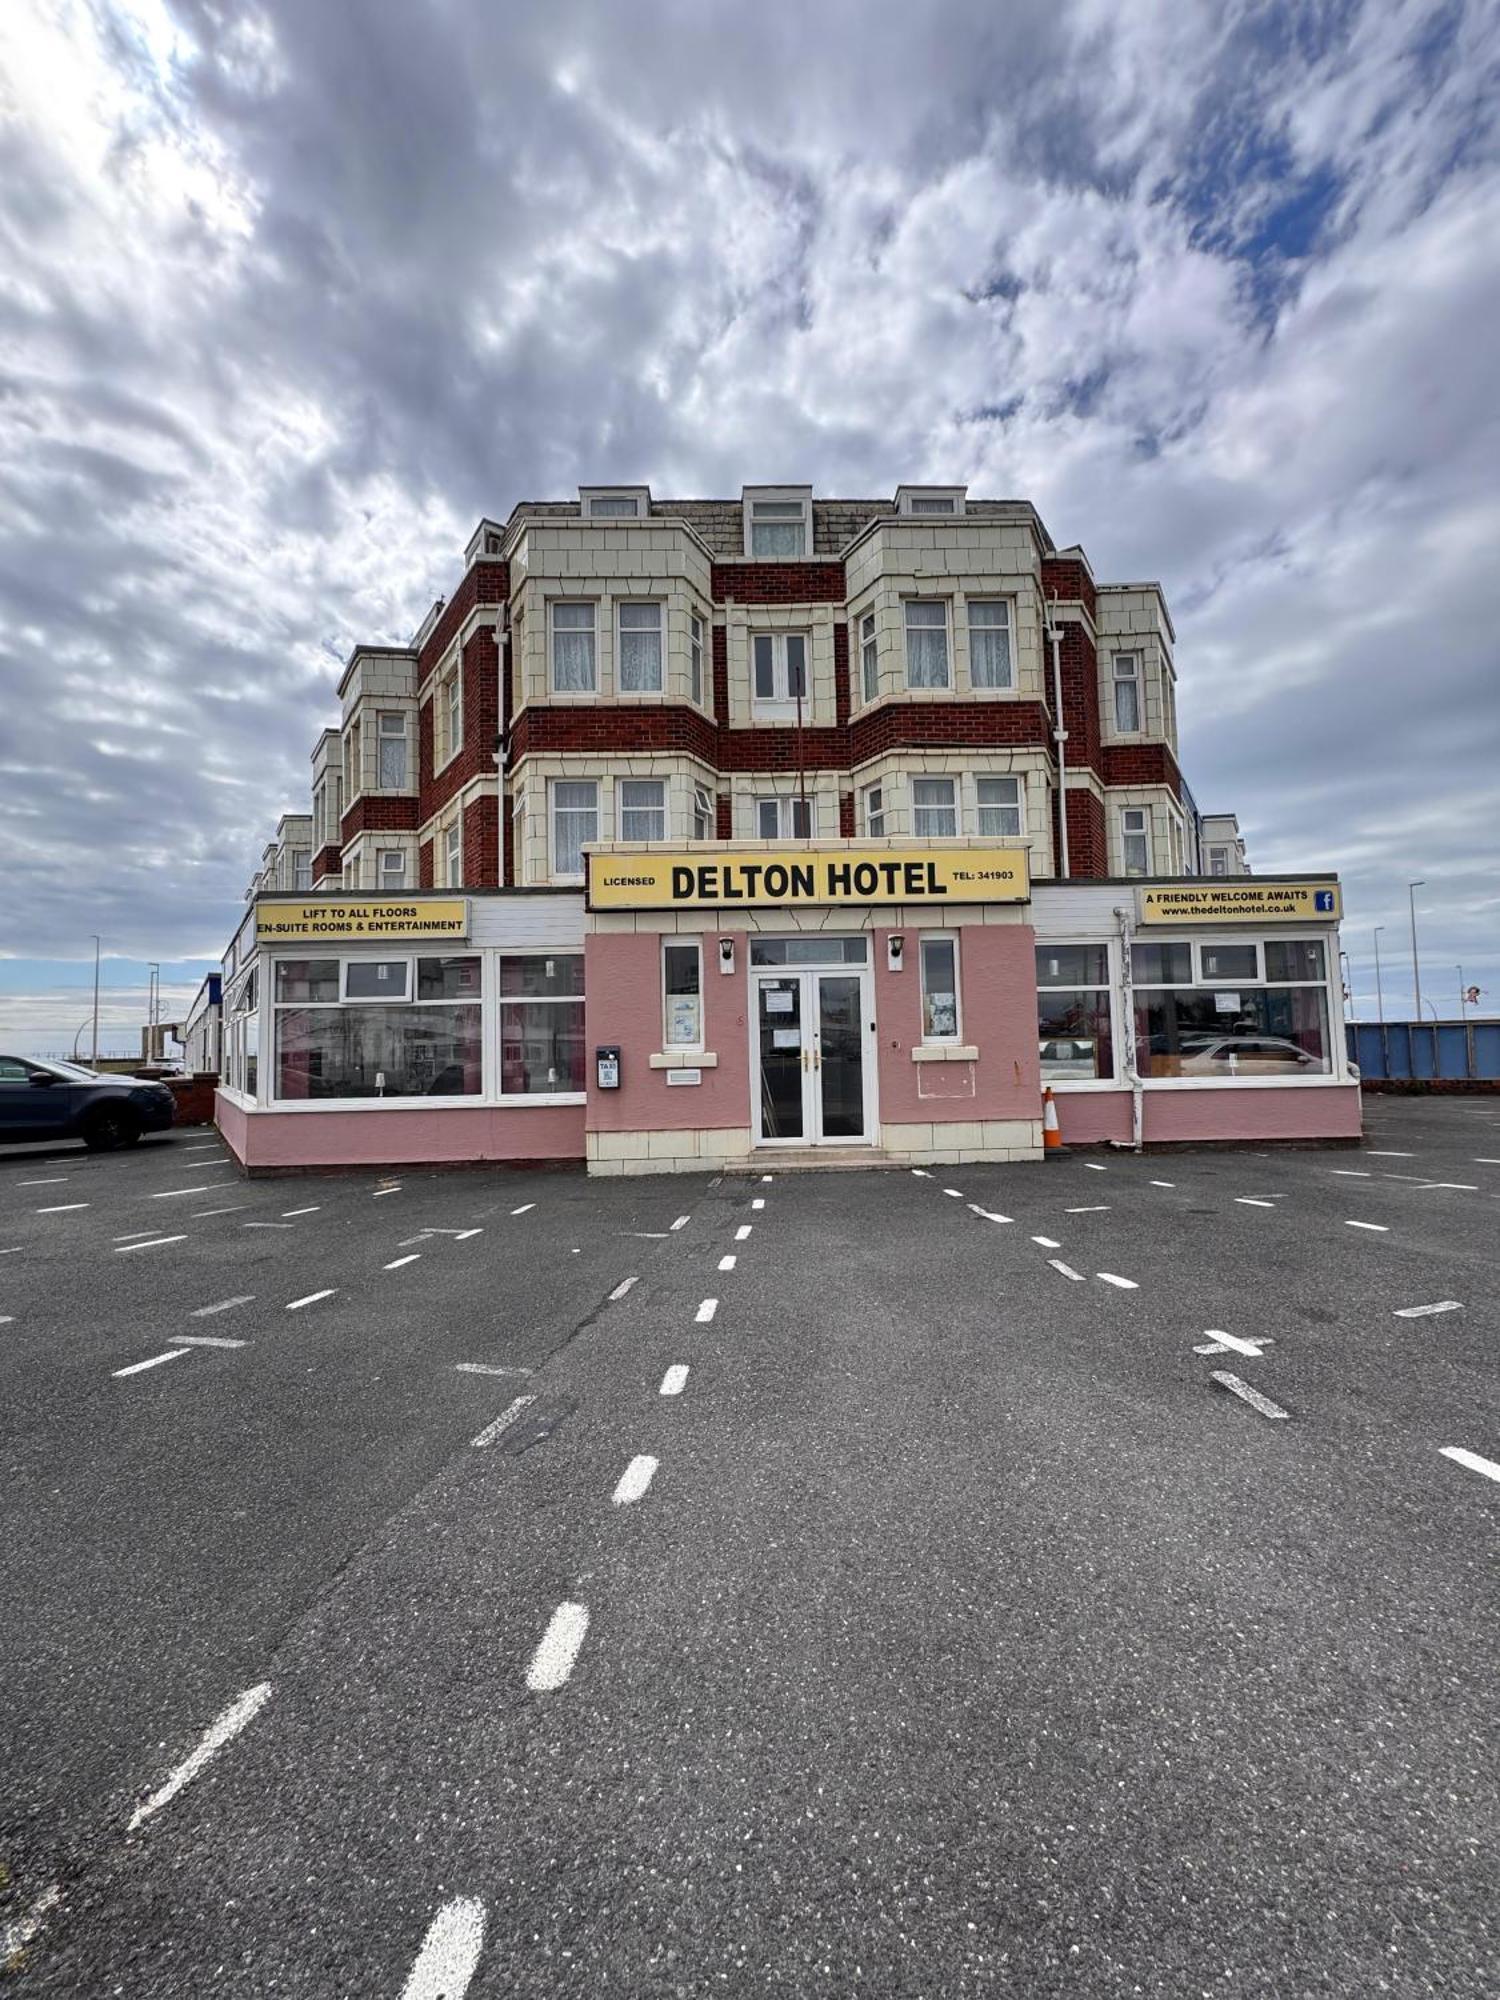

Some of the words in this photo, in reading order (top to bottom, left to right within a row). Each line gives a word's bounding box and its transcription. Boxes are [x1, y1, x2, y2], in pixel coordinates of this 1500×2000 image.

[603, 877, 655, 886] LICENSED
[672, 864, 815, 899] DELTON
[827, 863, 947, 896] HOTEL
[953, 872, 975, 881] TEL:
[977, 871, 1014, 880] 341903
[1146, 895, 1154, 903] A
[1157, 893, 1208, 902] FRIENDLY
[1211, 891, 1264, 901] WELCOME
[1266, 891, 1308, 900] AWAITS
[303, 909, 326, 918] LIFT
[331, 909, 345, 918] TO
[349, 909, 369, 918] ALL
[373, 908, 417, 917] FLOORS
[1162, 904, 1296, 915] www.thedeltonhotel.co.uk
[257, 923, 308, 932] EN-SUITE
[313, 922, 352, 931] ROOMS
[357, 922, 364, 931] &
[368, 921, 463, 931] ENTERTAINMENT
